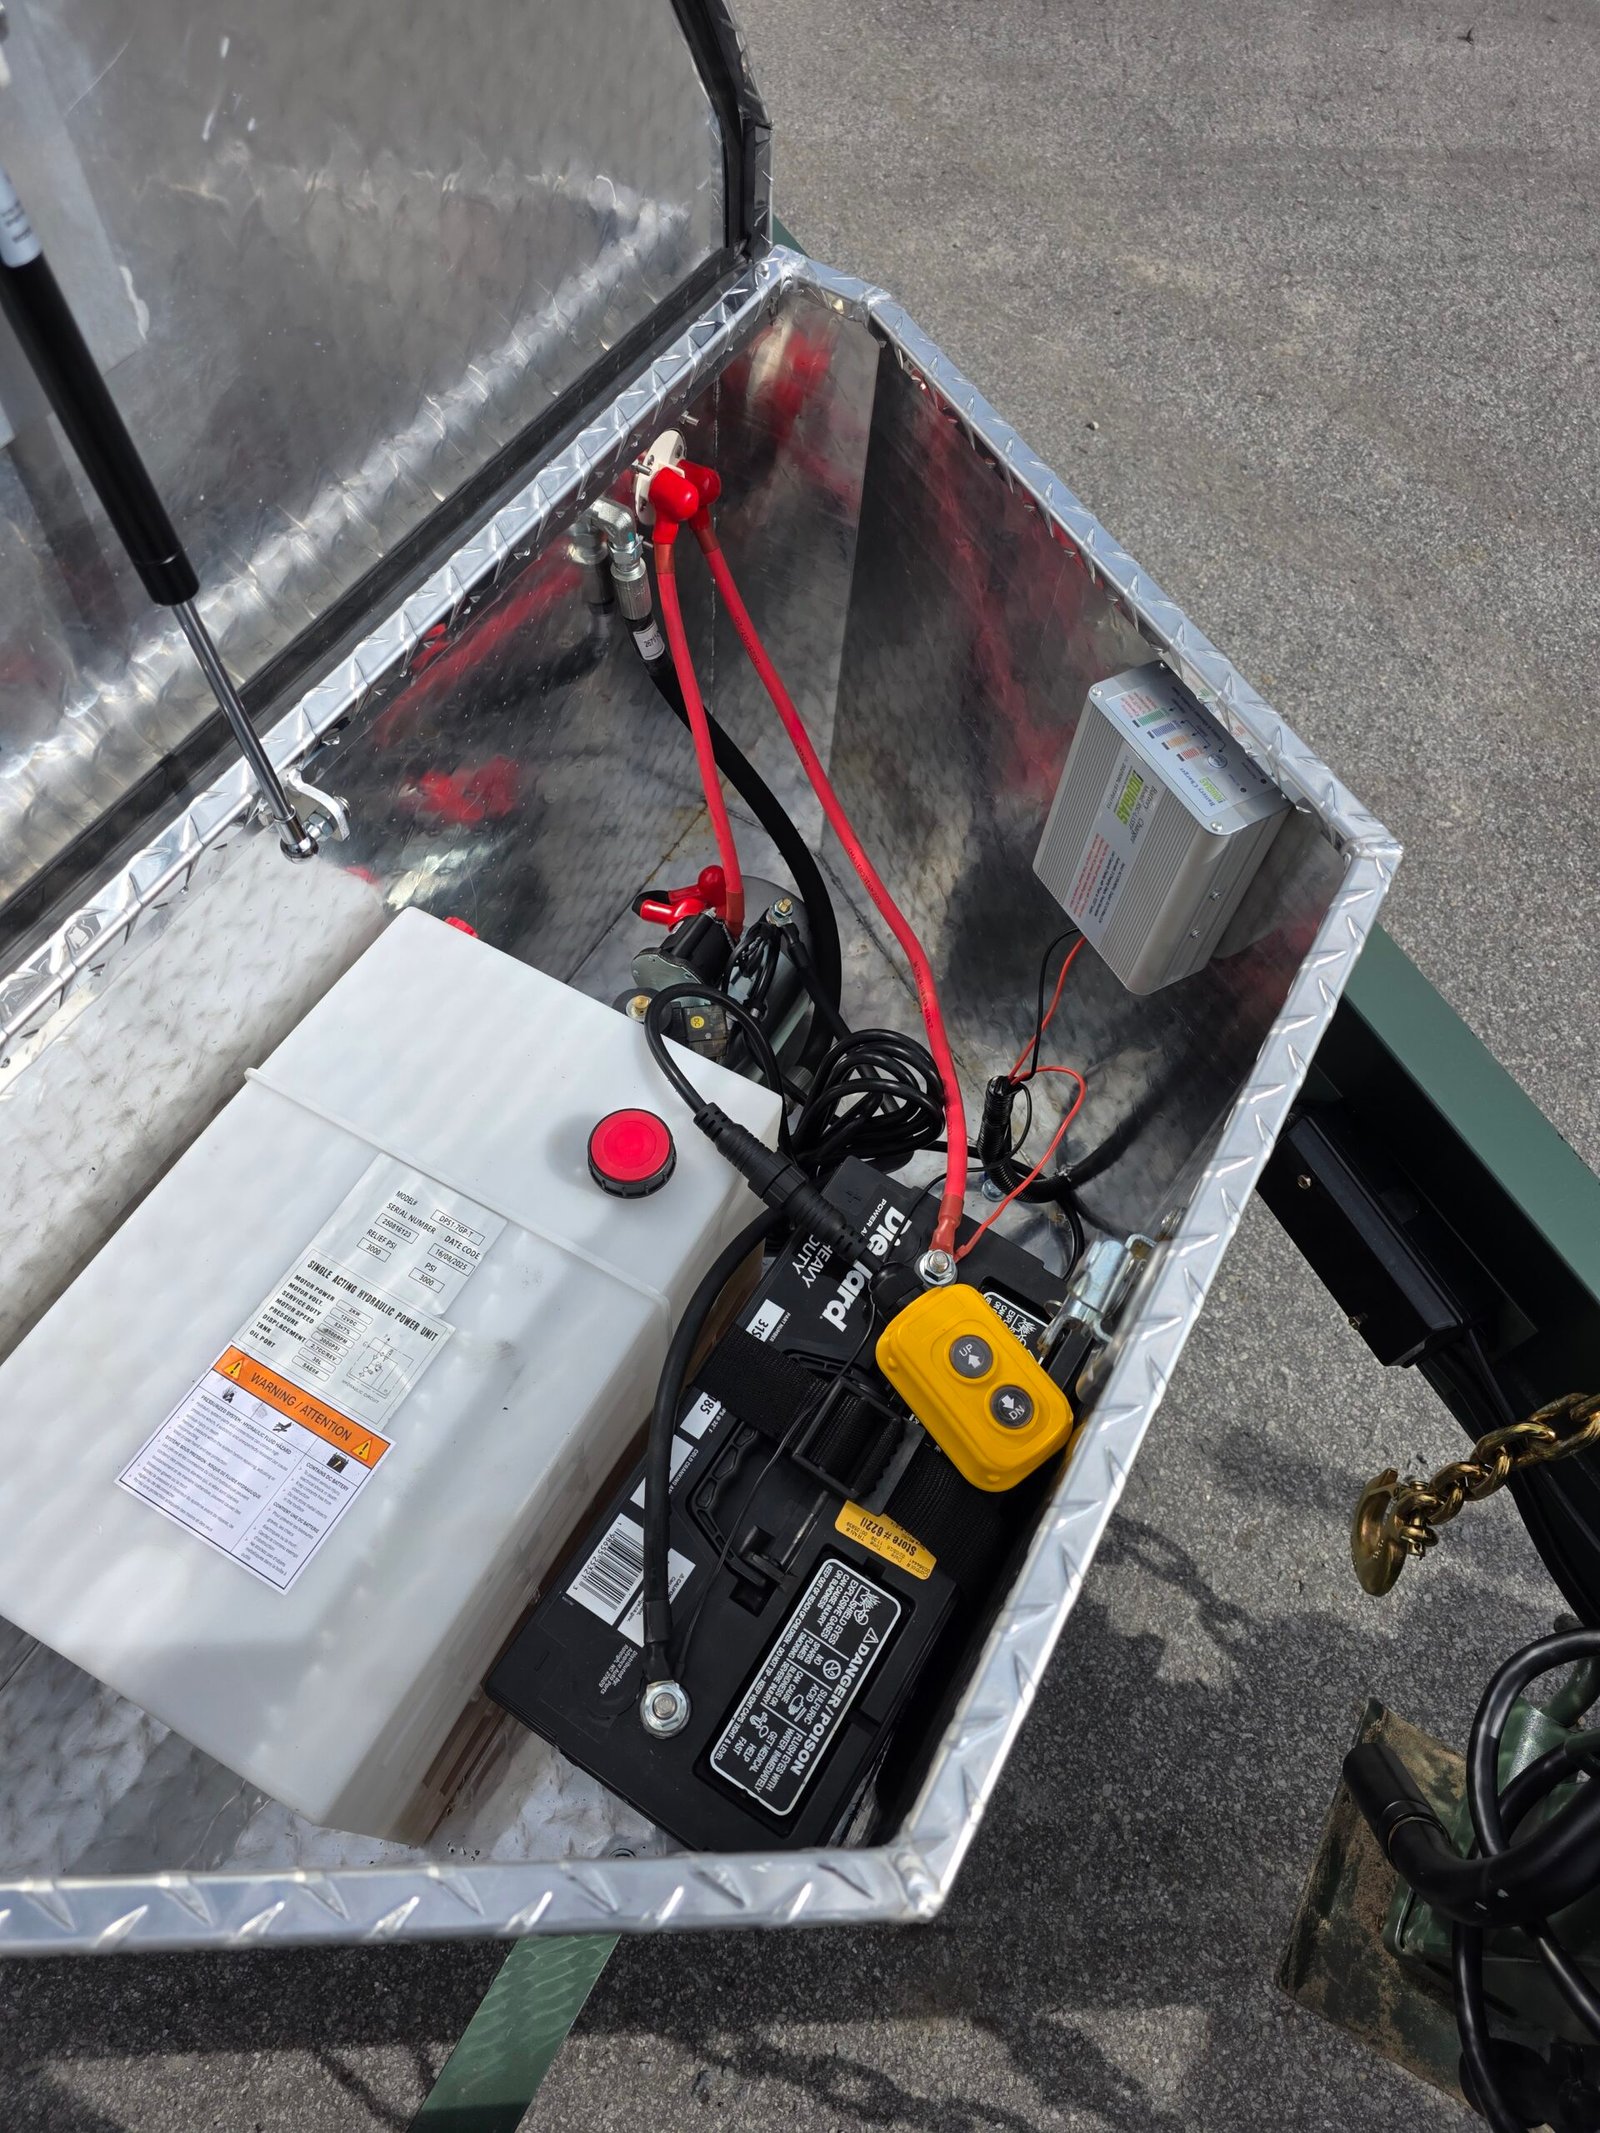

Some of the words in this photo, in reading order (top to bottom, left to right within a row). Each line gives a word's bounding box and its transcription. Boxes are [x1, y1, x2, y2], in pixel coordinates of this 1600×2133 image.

[1115, 769, 1144, 825] DOUGLAS
[395, 1190, 418, 1206] MODEL#
[386, 1202, 408, 1218] SERIAL
[407, 1214, 436, 1234] NUMBER
[864, 1197, 887, 1227] POWER
[366, 1228, 386, 1243] RELIEF
[385, 1239, 397, 1249] PSI
[443, 1235, 463, 1249] DATE
[460, 1244, 480, 1259] CODE
[366, 1244, 381, 1255] 3000
[434, 1248, 467, 1270] 16/08/2025
[424, 1262, 437, 1272] PSI
[287, 1282, 308, 1297] MOTOR
[293, 1274, 314, 1289] MOTOR
[313, 1286, 335, 1301] POWER
[418, 1274, 434, 1286] 3000
[280, 1290, 306, 1307] SERVICE
[305, 1304, 321, 1316] DUTY
[306, 1259, 333, 1279] SINGLE
[331, 1274, 358, 1294] ACTING
[356, 1289, 395, 1316] HYDRAULIC
[394, 1311, 420, 1331] POWER
[419, 1326, 438, 1341] UNIT
[268, 1305, 298, 1326] PRESSURE
[274, 1298, 295, 1313] MOTOR
[294, 1309, 314, 1324] SPEED
[255, 1321, 271, 1334] TANK
[261, 1313, 306, 1343] DISPLACEMENT
[248, 1329, 259, 1339] OIL
[258, 1335, 275, 1348] PORT
[959, 1343, 973, 1357] UP
[248, 1372, 298, 1406] WARNING
[299, 1403, 352, 1441] ATTENTION
[1008, 1404, 1025, 1420] DN
[687, 1448, 699, 1462] COLD
[671, 1460, 690, 1485] CRANKING
[882, 1529, 892, 1540] #
[868, 1540, 881, 1550] Time
[890, 1534, 917, 1556] Store
[889, 1552, 902, 1562] Date
[821, 1563, 833, 1578] KEEP
[833, 1569, 843, 1580] OR
[838, 1573, 850, 1587] CAN
[811, 1586, 820, 1596] OF
[815, 1576, 826, 1588] OUT
[801, 1593, 816, 1612] REACH
[816, 1577, 838, 1609] BLINDNESS
[828, 1584, 843, 1605] CAUSE
[832, 1579, 858, 1617] EXPLOSIVE
[797, 1610, 806, 1619] OF
[815, 1602, 833, 1626] INJURY
[837, 1599, 857, 1626] SHIELD
[782, 1617, 801, 1644] CHILDREN
[819, 1614, 838, 1639] GASES
[827, 1624, 843, 1645] EYES
[775, 1646, 785, 1656] DO
[787, 1631, 806, 1659] SMOKING
[796, 1636, 813, 1660] FLAMES
[803, 1640, 820, 1664] SPARKS
[607, 1663, 615, 1672] NC
[616, 1647, 633, 1668] Advance
[617, 1650, 637, 1678] Distributed
[769, 1654, 780, 1667] NOT
[812, 1653, 824, 1666] NO
[609, 1667, 619, 1680] Auto
[764, 1665, 773, 1676] TIP
[772, 1660, 789, 1683] SEVERE
[791, 1669, 803, 1684] CAN
[599, 1680, 611, 1694] Parts
[611, 1677, 620, 1686] by:
[753, 1678, 766, 1694] KEEP
[773, 1665, 796, 1698] BLINDNESS
[745, 1692, 758, 1709] VENT
[760, 1681, 777, 1704] INJURY
[768, 1696, 778, 1707] OR
[780, 1682, 796, 1703] CAUSE
[804, 1683, 820, 1703] ACID
[736, 1706, 749, 1723] CAPS
[803, 1688, 828, 1725] SULFURIC
[727, 1721, 740, 1739] TIGHT
[764, 1730, 777, 1747] GET
[776, 1726, 794, 1751] WATER
[714, 1742, 728, 1761] LEVEL
[731, 1736, 746, 1755] FAST
[741, 1742, 756, 1762] HELP
[785, 1732, 803, 1756] FLUSH
[748, 1744, 769, 1773] MEDICAL
[775, 1753, 790, 1774] EYES
[752, 1749, 781, 1792] IMMEDIATELY
[765, 1771, 780, 1791] WITH
